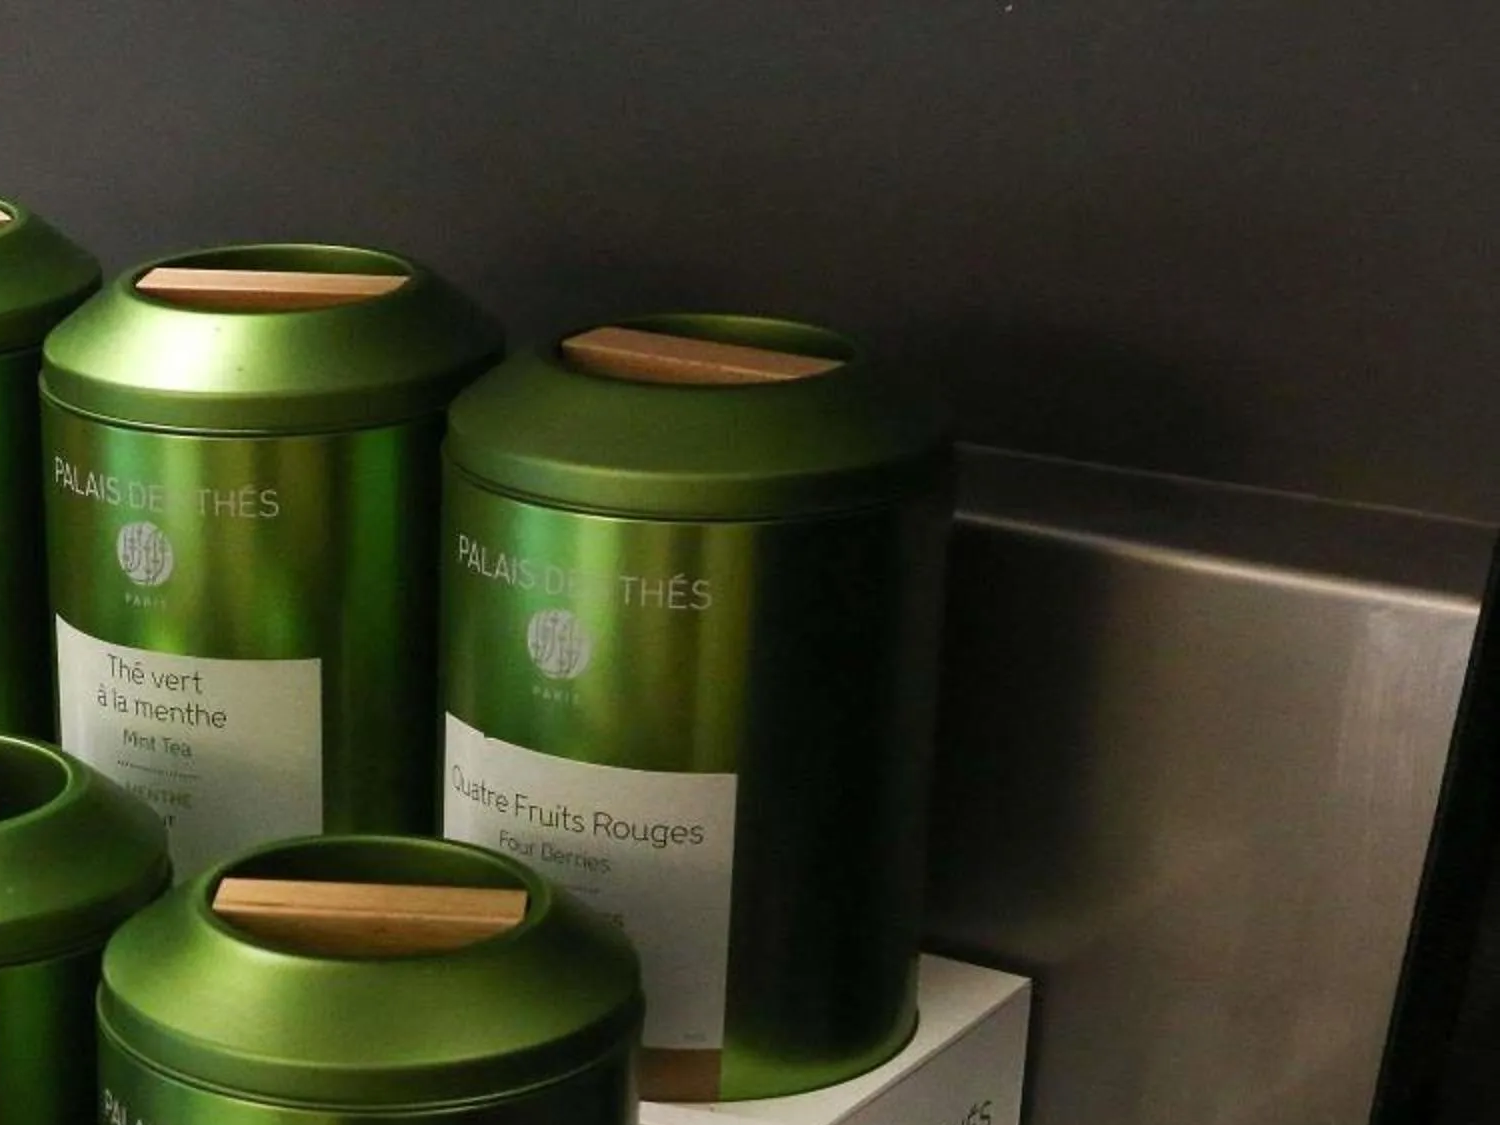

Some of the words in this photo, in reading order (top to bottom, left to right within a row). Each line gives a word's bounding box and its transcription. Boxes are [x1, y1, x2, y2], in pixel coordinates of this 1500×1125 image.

[55, 456, 121, 506] PALAIS
[128, 480, 170, 514] DE
[197, 482, 280, 519] THÉS
[457, 534, 536, 591] PALAIS
[618, 572, 713, 612] THÉS
[107, 652, 145, 686] Thé
[151, 670, 204, 695] vert
[96, 682, 108, 708] à
[113, 687, 128, 714] la
[134, 698, 228, 729] menthe
[162, 736, 192, 758] Tea
[451, 763, 510, 814] Quatre
[514, 792, 586, 834] Fruits
[592, 811, 706, 849] Rouges
[499, 829, 536, 855] Four
